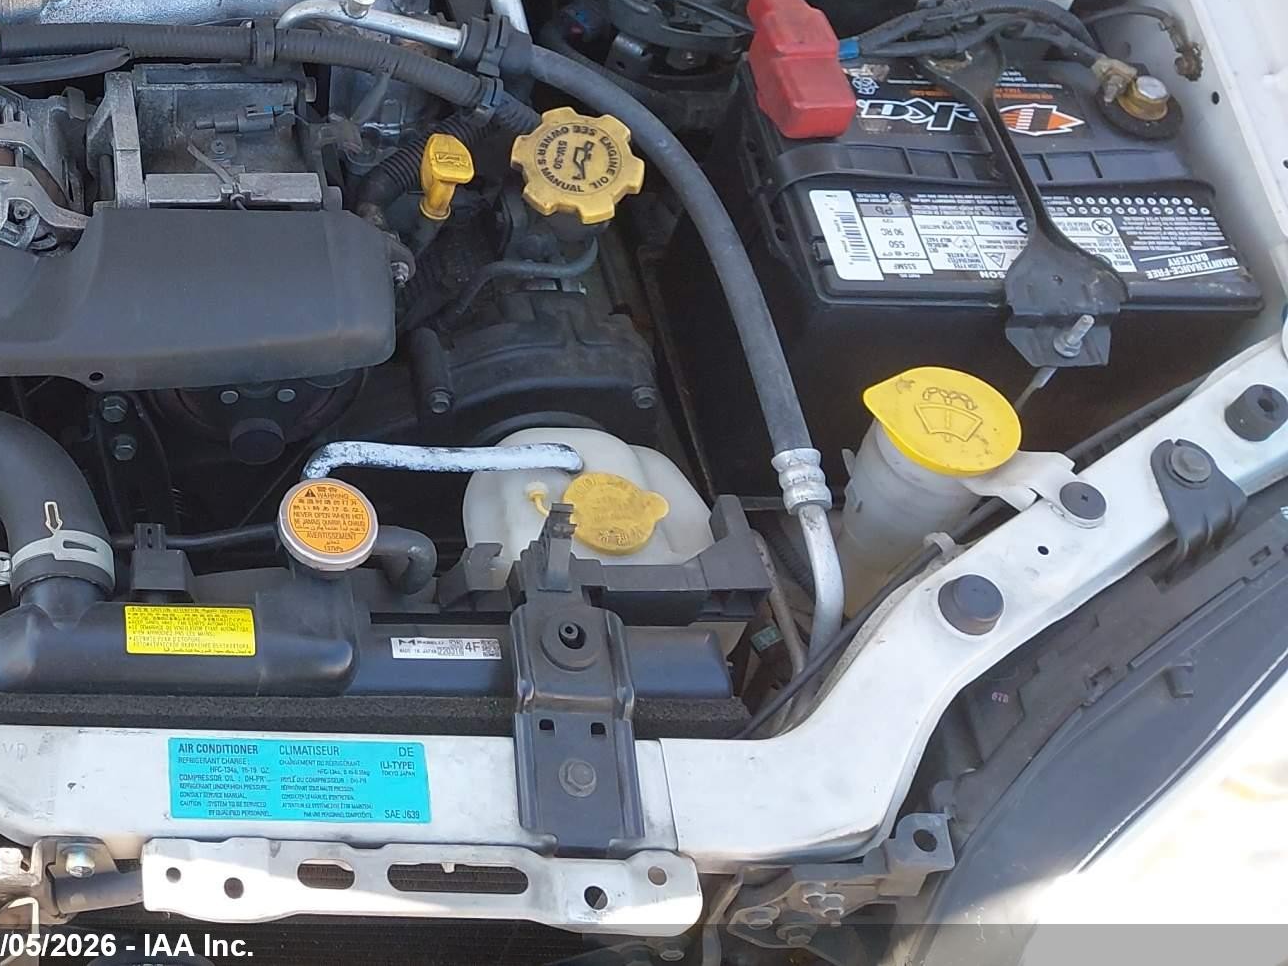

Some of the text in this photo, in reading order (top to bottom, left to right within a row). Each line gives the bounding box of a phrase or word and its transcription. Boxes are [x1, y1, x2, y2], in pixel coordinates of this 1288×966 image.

[536, 125, 597, 193] SEE OWNER'S MANUAL
[553, 140, 568, 169] 5W-30
[590, 136, 618, 189] ENGINE OIL
[895, 228, 904, 236] 90
[888, 240, 905, 248] 550
[1167, 252, 1208, 266] BATTERY
[1144, 256, 1238, 279] MAINTENANCE-FREE
[465, 642, 480, 652] 4F
[178, 744, 259, 754] AIR CONDITIONER
[279, 745, 339, 756] CLIMATISEUR
[399, 747, 414, 757] DE
[179, 774, 222, 782] COMPRESSOR
[385, 810, 401, 819] SAE
